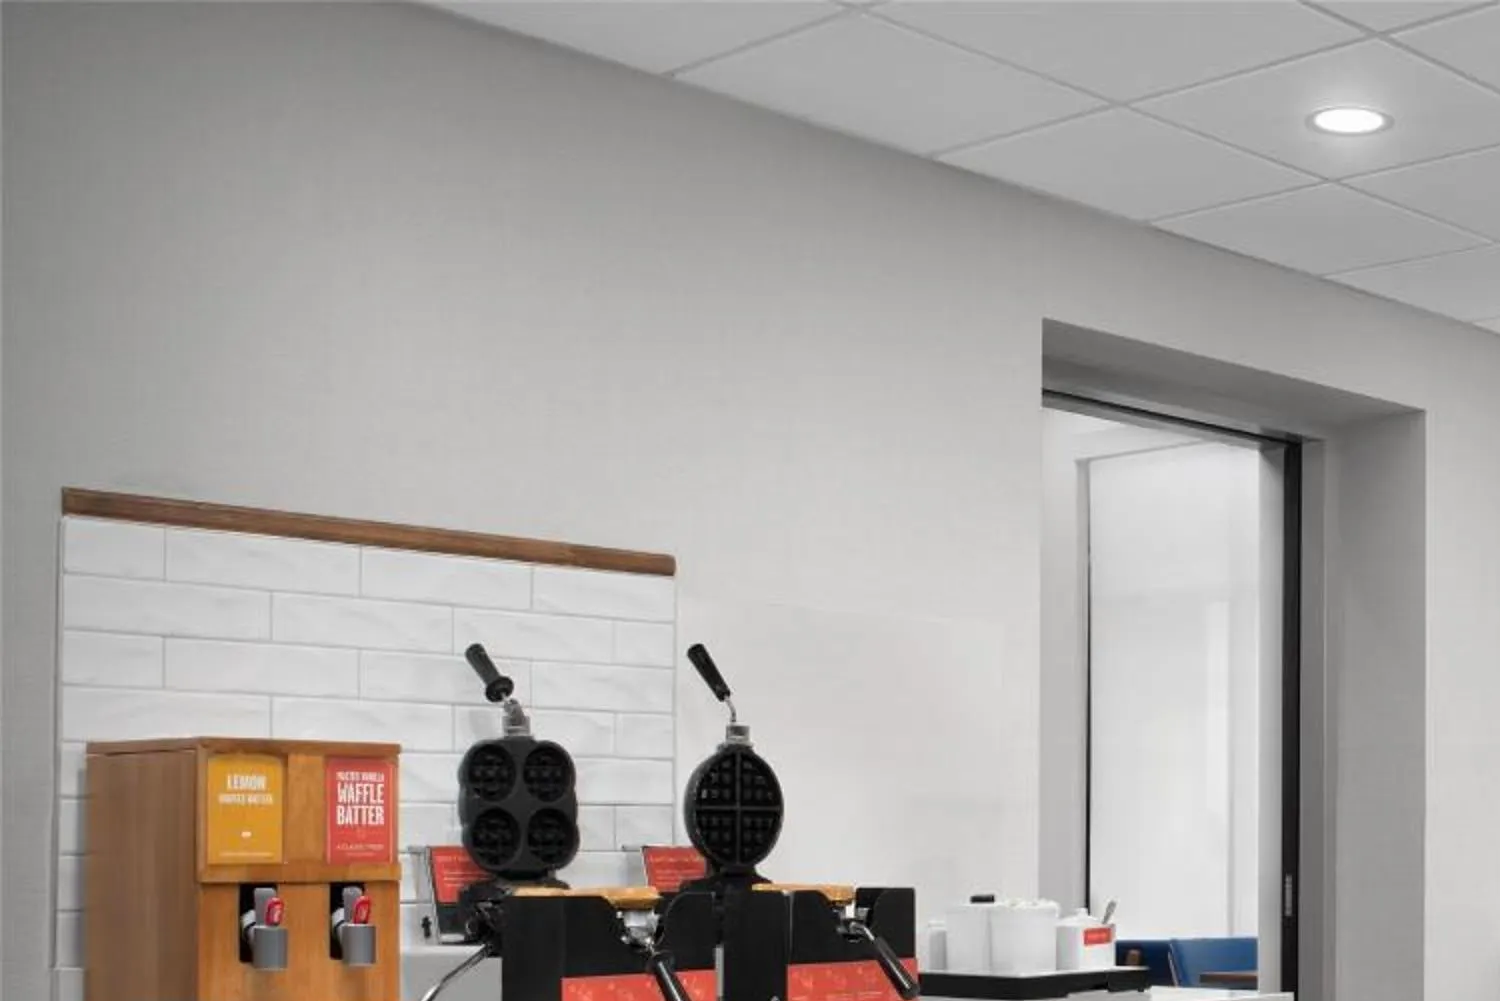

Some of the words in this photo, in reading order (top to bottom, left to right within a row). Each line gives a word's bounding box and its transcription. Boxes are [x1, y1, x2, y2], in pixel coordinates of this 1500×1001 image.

[226, 775, 267, 790] LEMON
[337, 782, 384, 804] WAFFLE
[336, 805, 384, 826] BATTER
